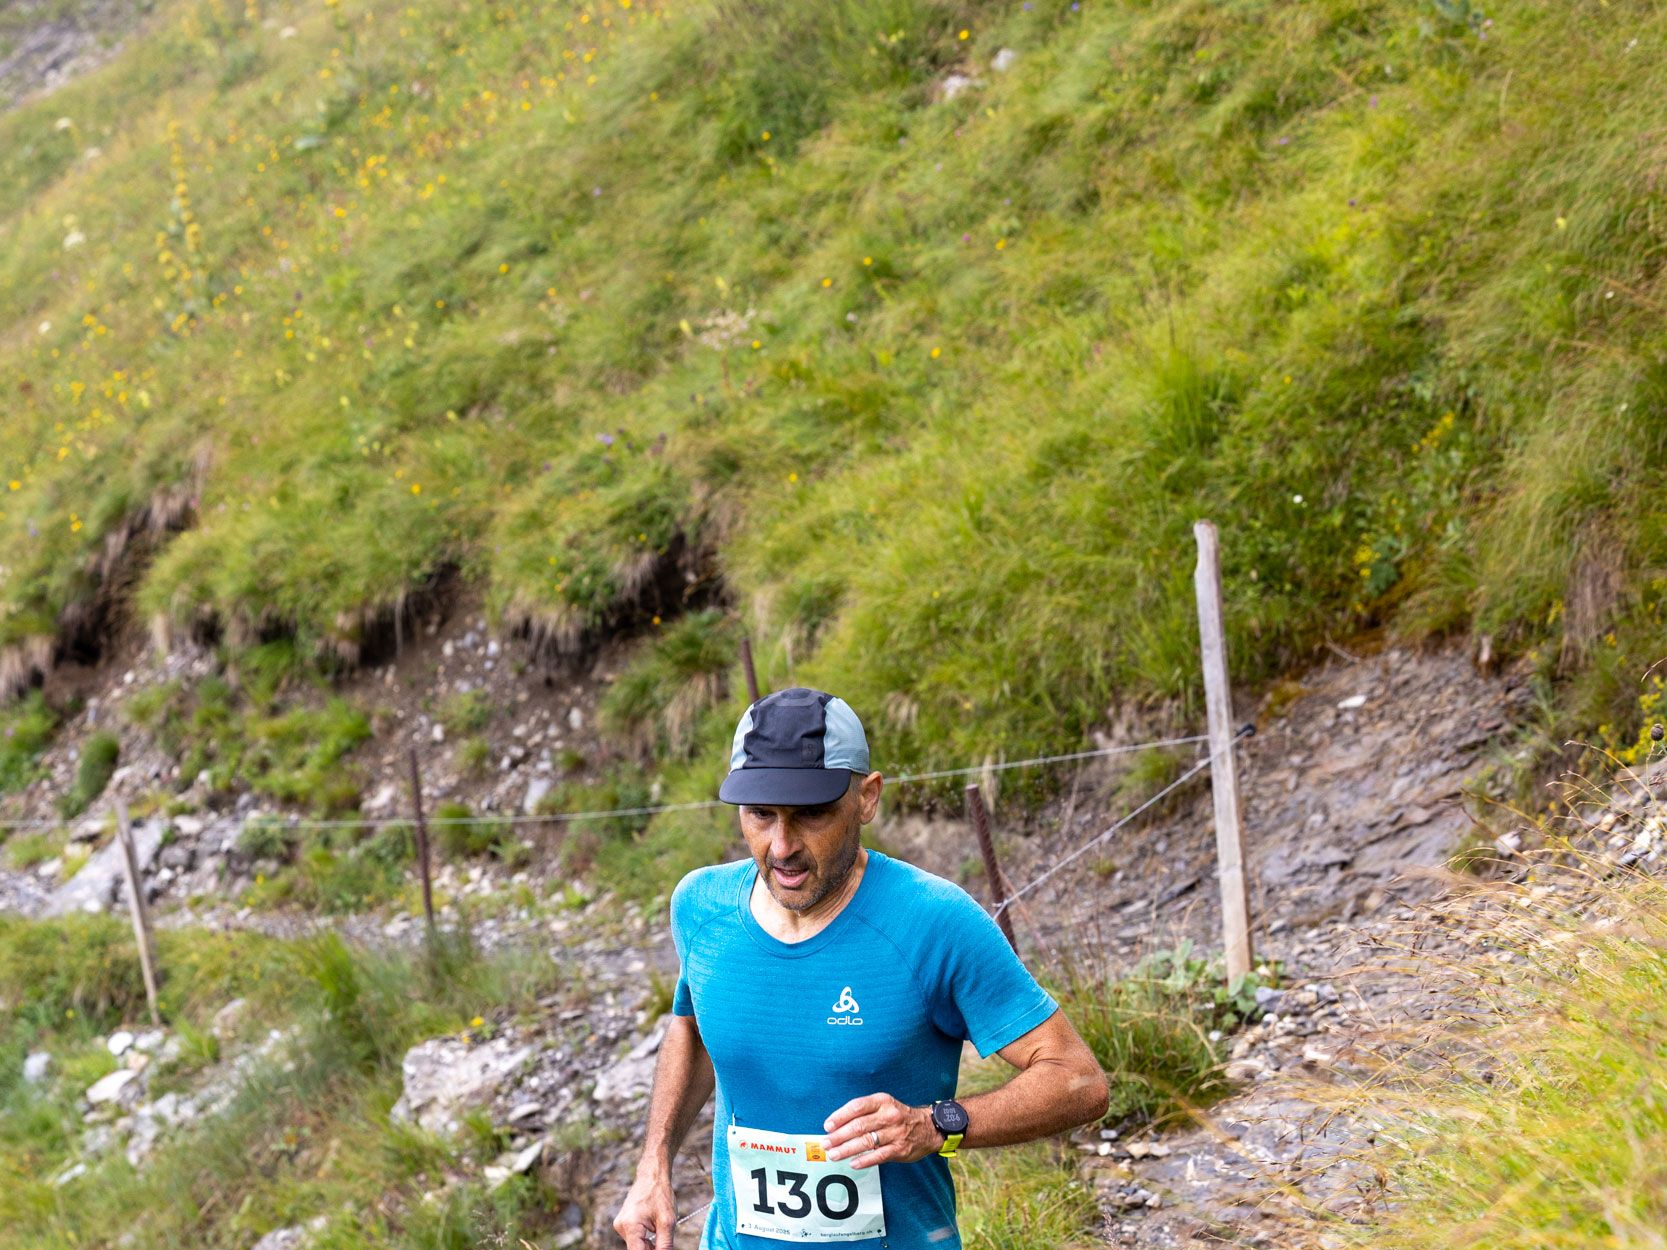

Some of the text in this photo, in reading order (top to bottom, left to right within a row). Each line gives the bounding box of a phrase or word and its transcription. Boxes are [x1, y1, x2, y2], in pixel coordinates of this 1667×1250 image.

[827, 1016, 863, 1025] odlo
[751, 1142, 797, 1154] MAMMUT
[750, 1167, 859, 1220] 130
[753, 1224, 775, 1233] August
